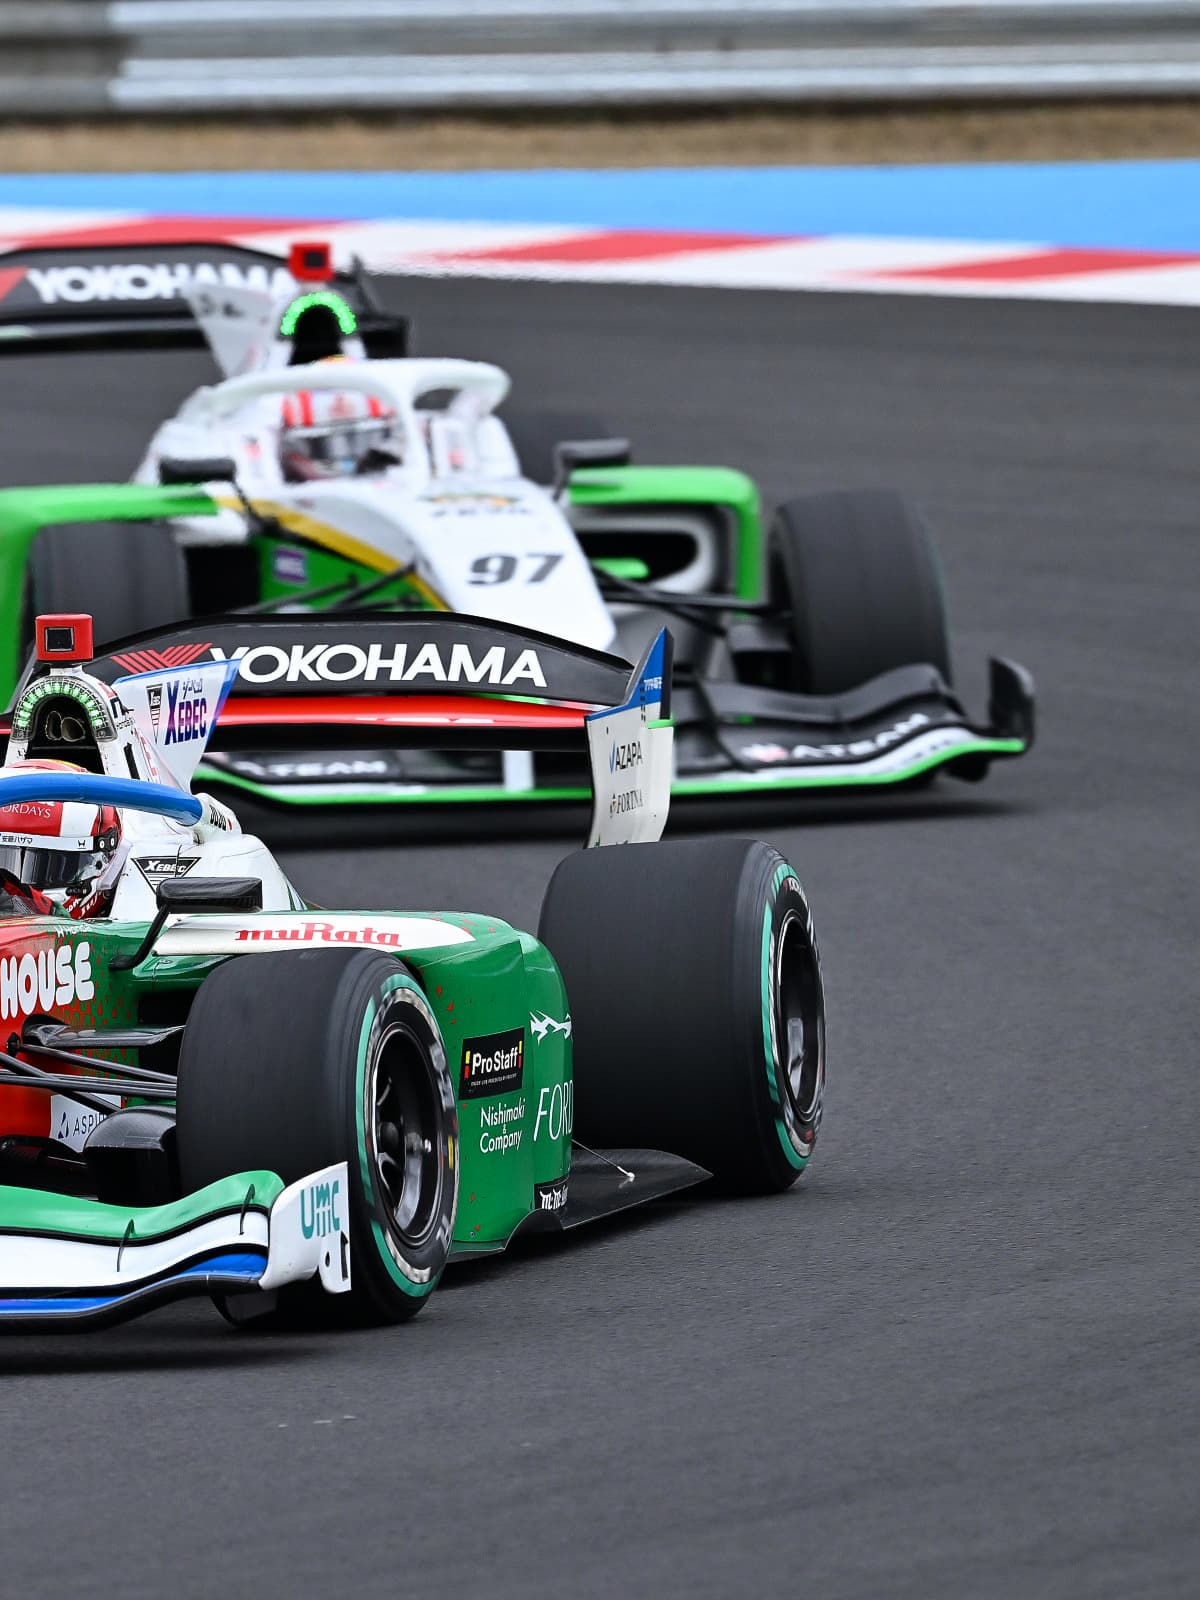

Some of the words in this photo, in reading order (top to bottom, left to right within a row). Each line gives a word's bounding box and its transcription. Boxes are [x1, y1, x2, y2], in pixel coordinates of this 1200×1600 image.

[466, 553, 563, 585] 97
[210, 643, 547, 687] YOKOHAMA
[164, 680, 207, 745] XEBEC
[144, 860, 187, 873] XEBEC
[1, 941, 95, 1020] HOUSE
[480, 1097, 526, 1129] Nishimaki
[480, 1129, 523, 1155] Company
